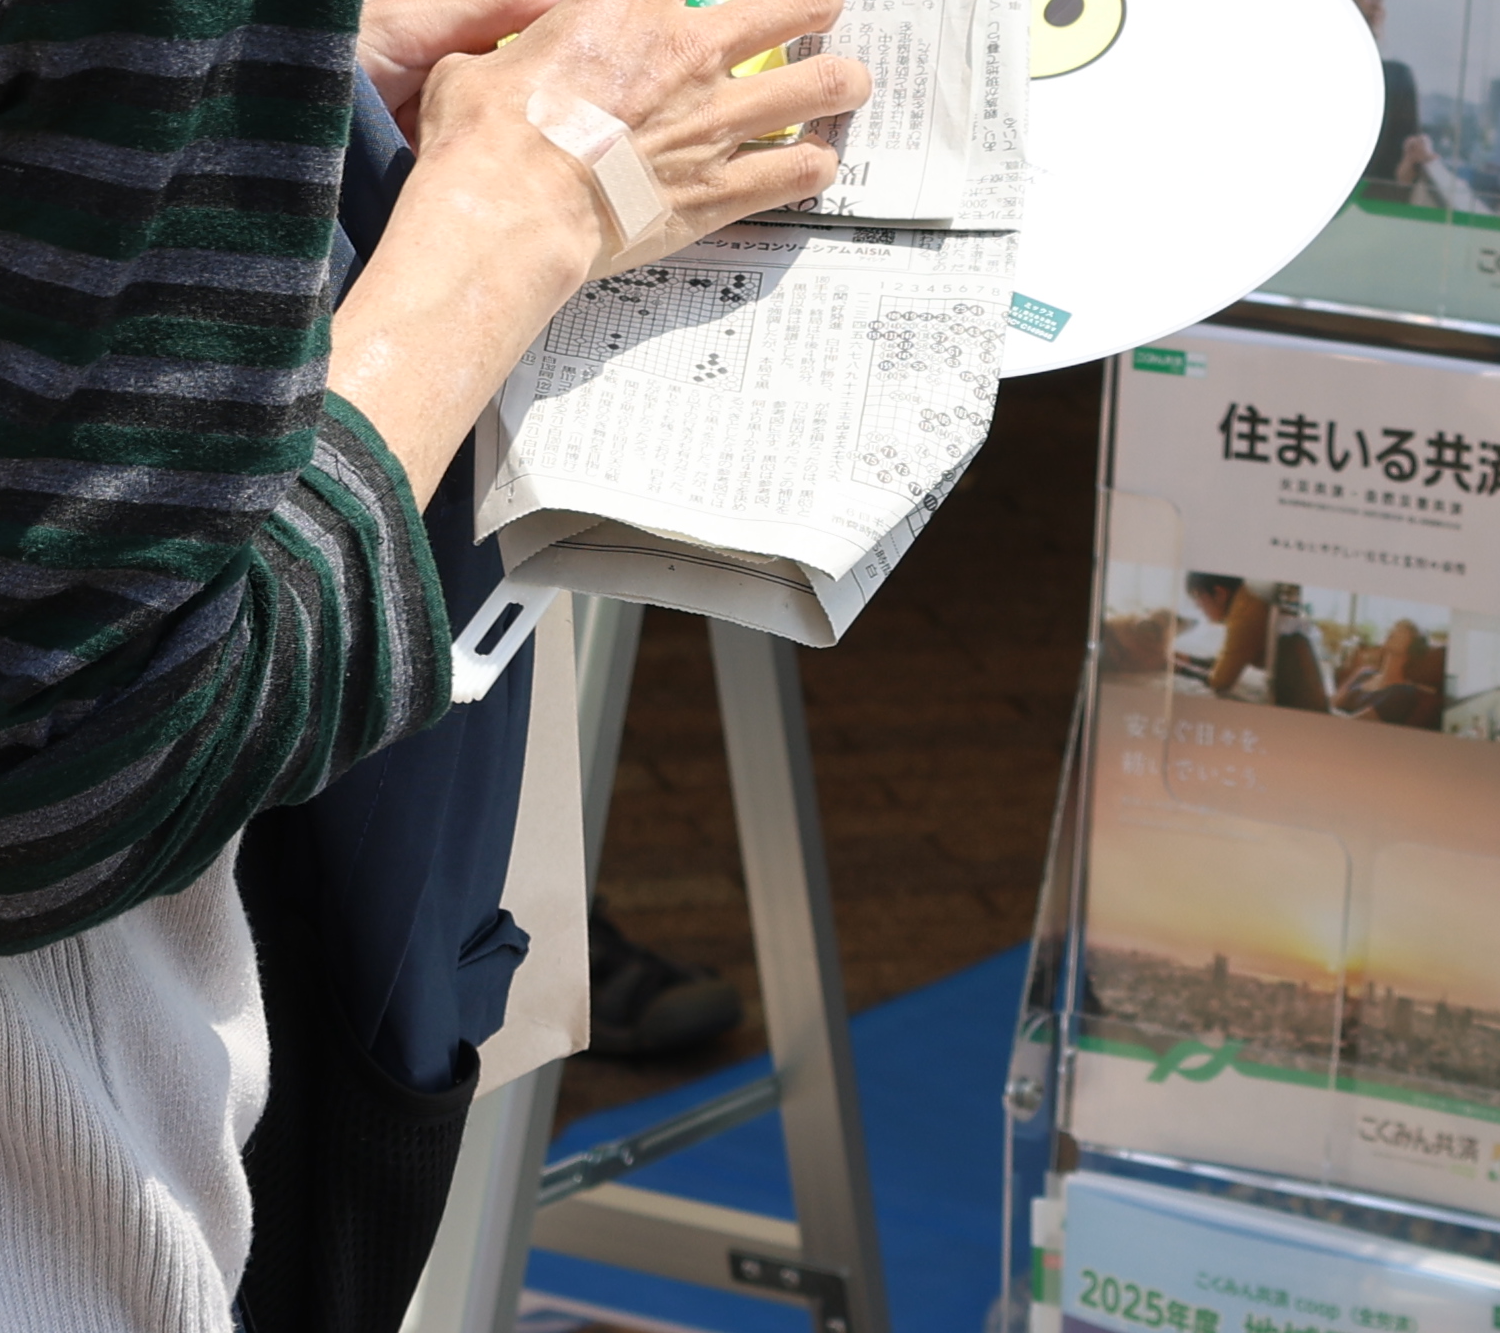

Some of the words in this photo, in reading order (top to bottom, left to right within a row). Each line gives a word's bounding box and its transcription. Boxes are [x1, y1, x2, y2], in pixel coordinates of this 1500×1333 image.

[1358, 1115, 1480, 1163] こくみん共済
[1077, 1266, 1221, 1333] 2025年度
[1194, 1268, 1291, 1310] こくみん共済
[1294, 1293, 1342, 1323] coop
